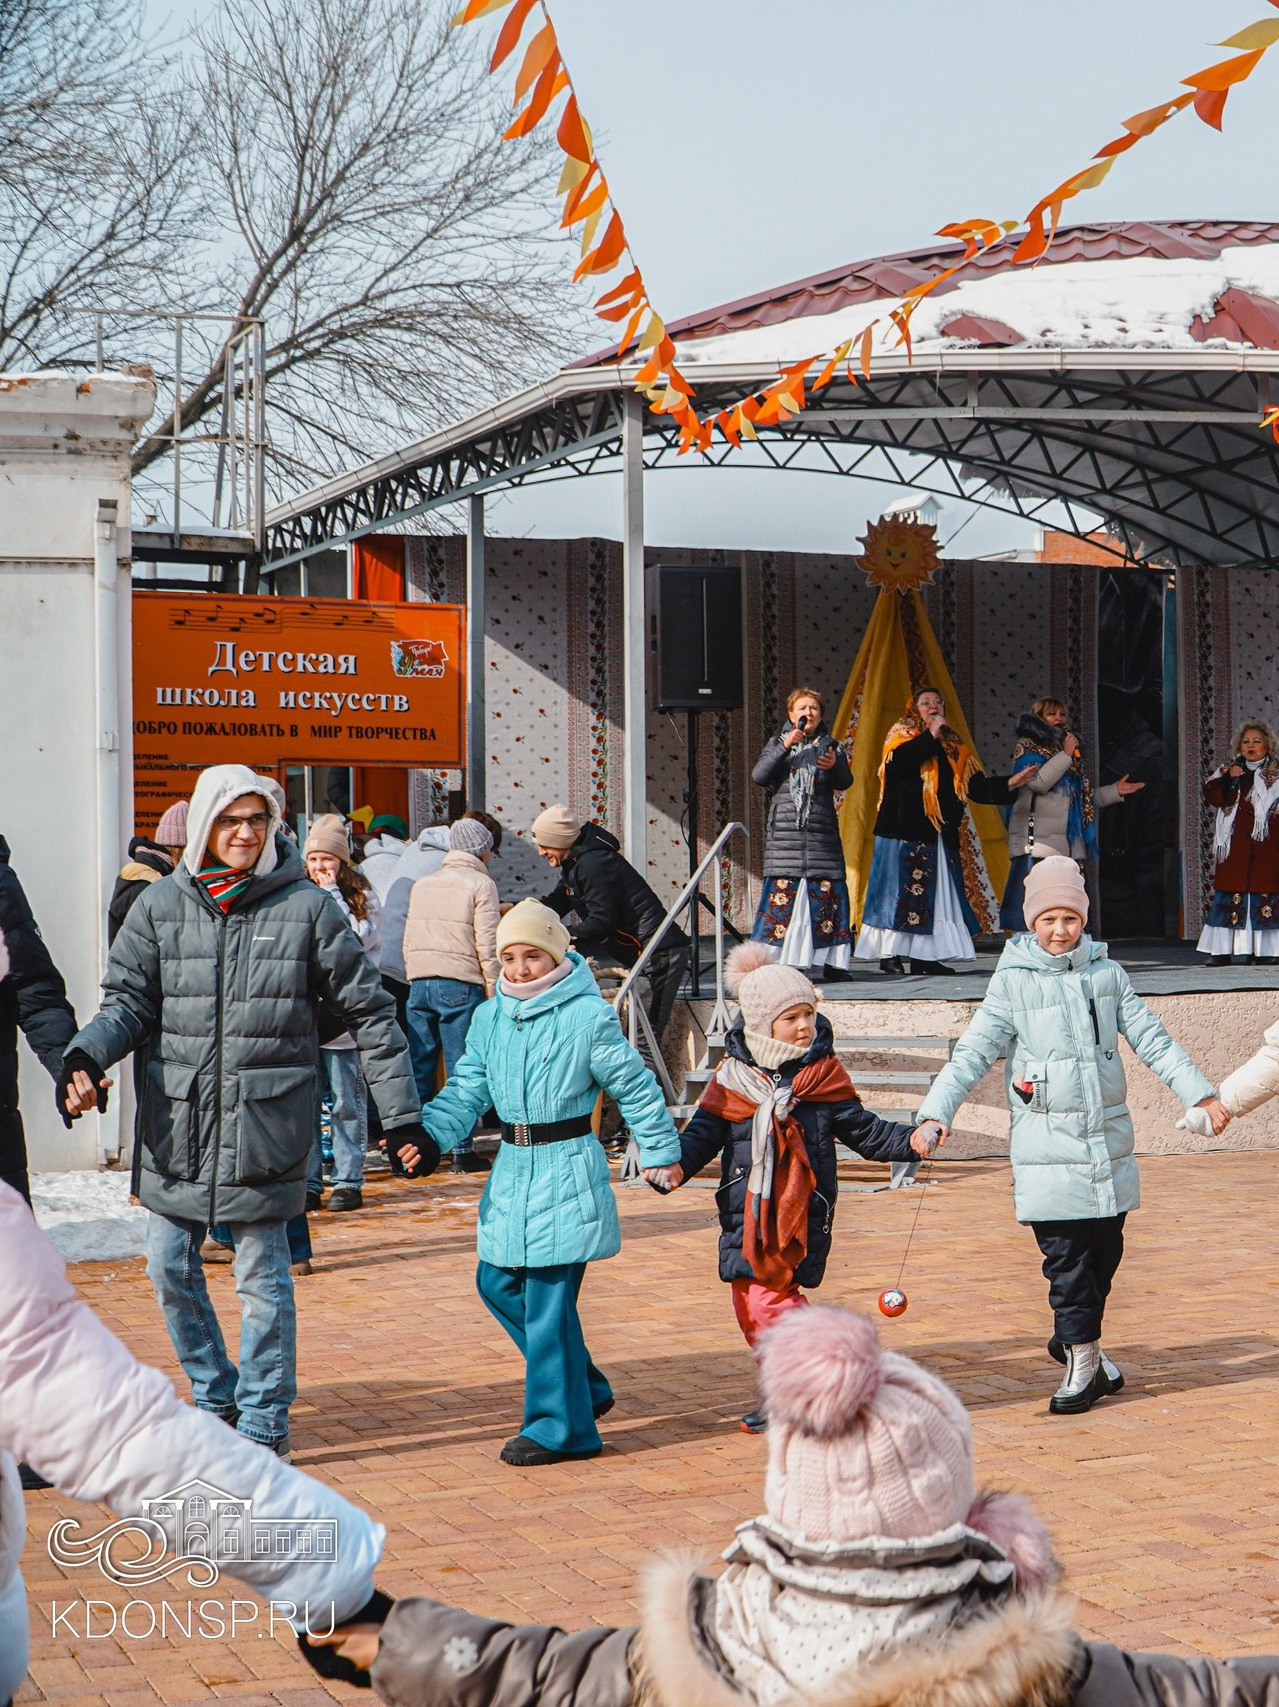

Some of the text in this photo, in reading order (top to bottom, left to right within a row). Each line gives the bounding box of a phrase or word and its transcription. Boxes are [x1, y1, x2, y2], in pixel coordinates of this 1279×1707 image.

[207, 641, 358, 678] Детская
[410, 667, 444, 677] МАЯ
[155, 686, 410, 717] школа искусств
[181, 721, 285, 738] ПОЖАЛОВАТЬ
[289, 723, 299, 738] В
[310, 725, 343, 740] МИР
[347, 726, 437, 742] ТВОРЧЕСТВА
